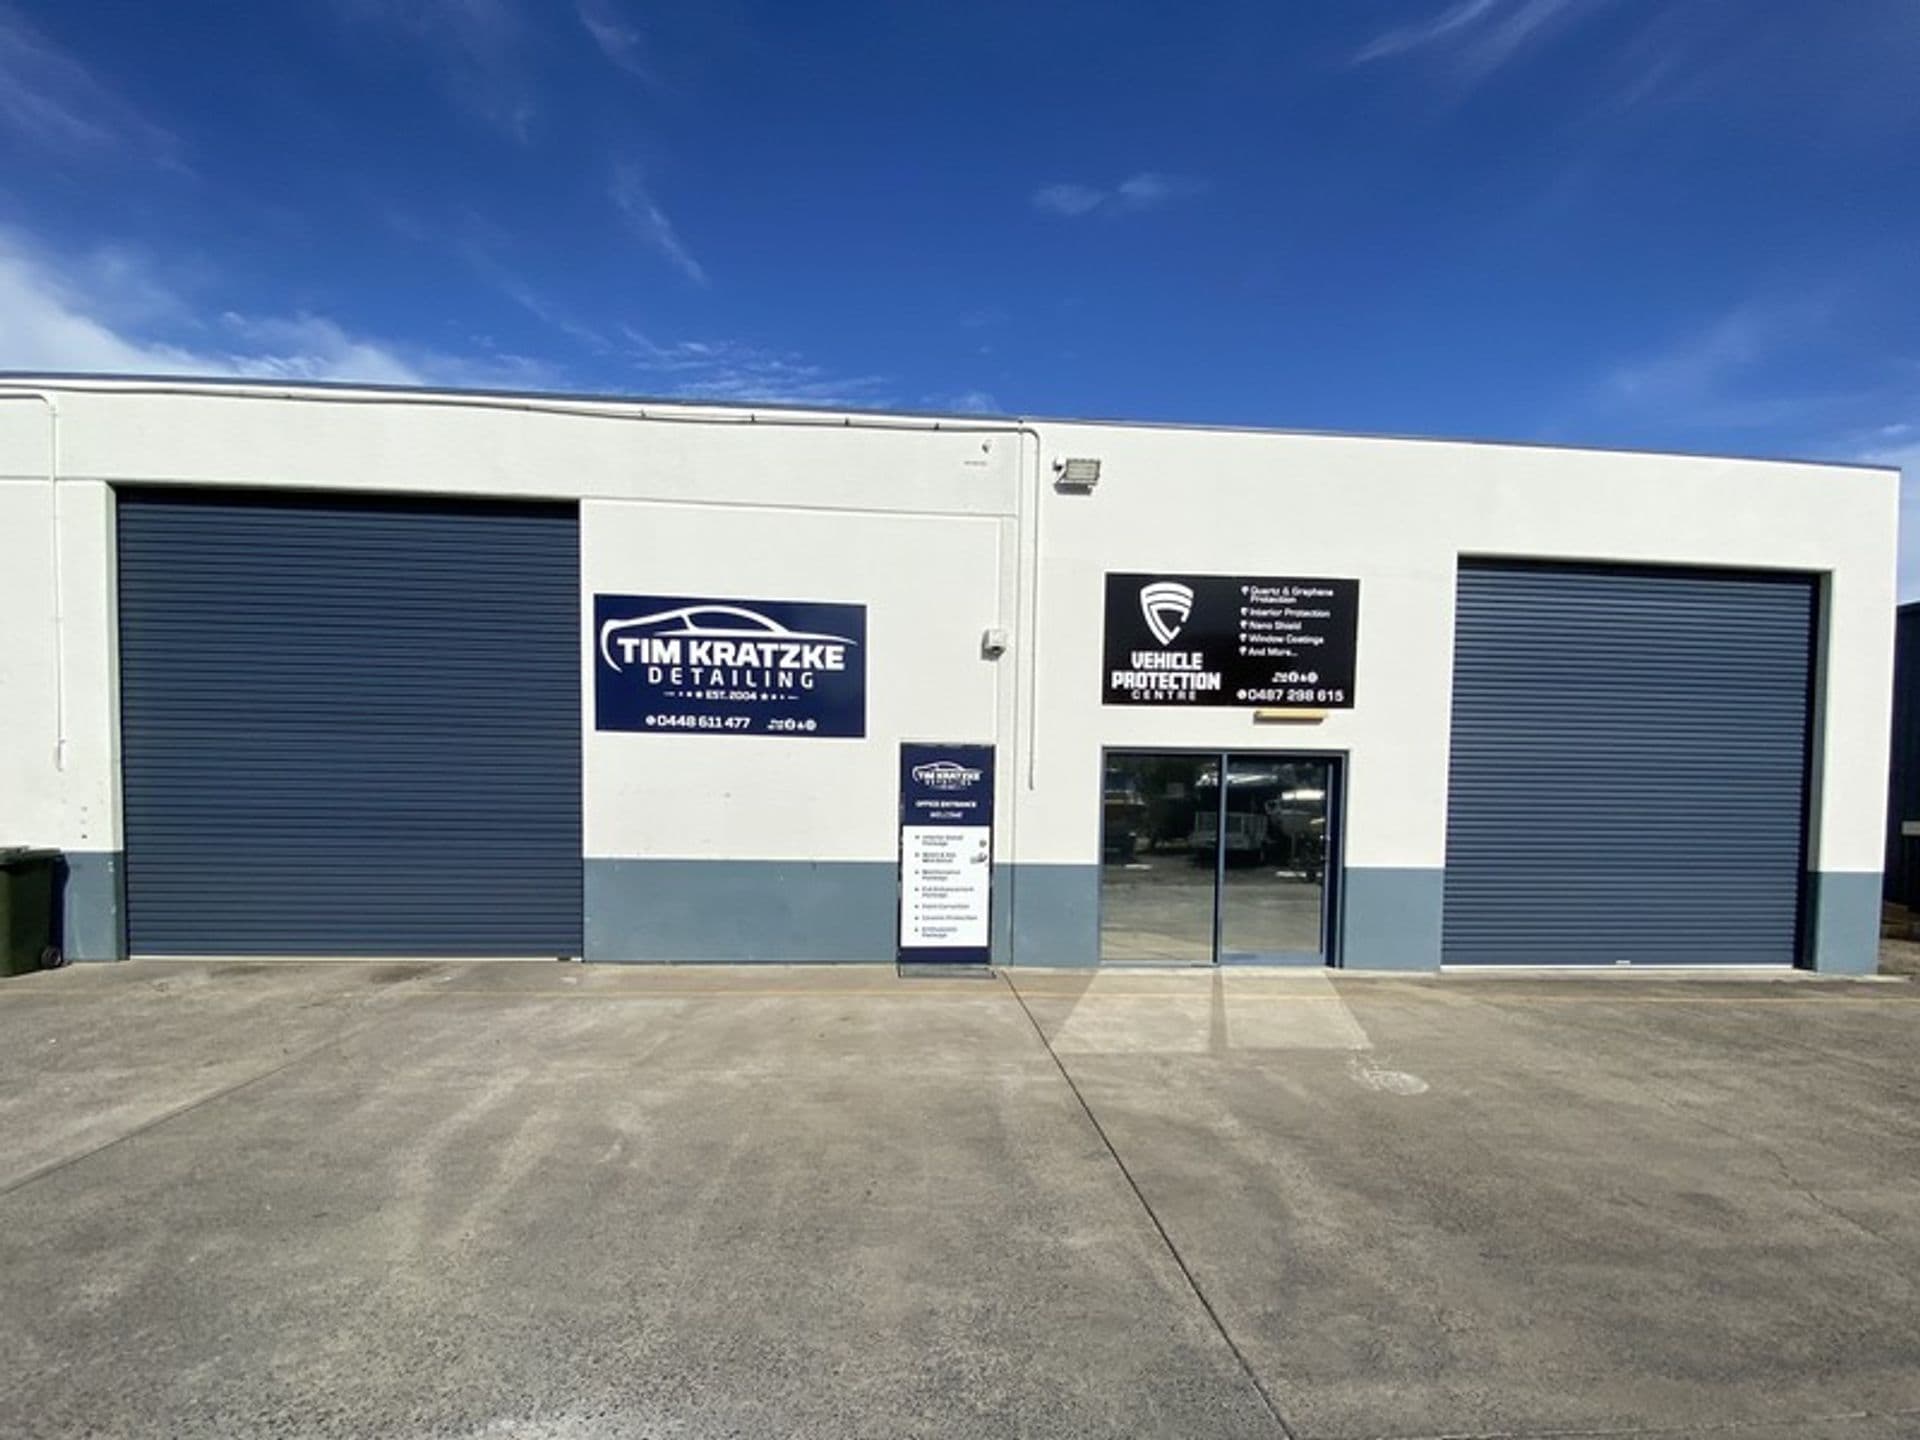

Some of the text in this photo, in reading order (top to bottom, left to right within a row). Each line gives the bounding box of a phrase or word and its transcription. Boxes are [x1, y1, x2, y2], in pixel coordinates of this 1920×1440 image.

[617, 638, 846, 670] TIM KRATZKE
[1131, 651, 1203, 670] VEHICLE
[648, 666, 815, 689] DETAILING
[1111, 671, 1221, 690] PROTECTION
[1131, 689, 1196, 700] CENTRE
[657, 714, 750, 729] 0448 611 477
